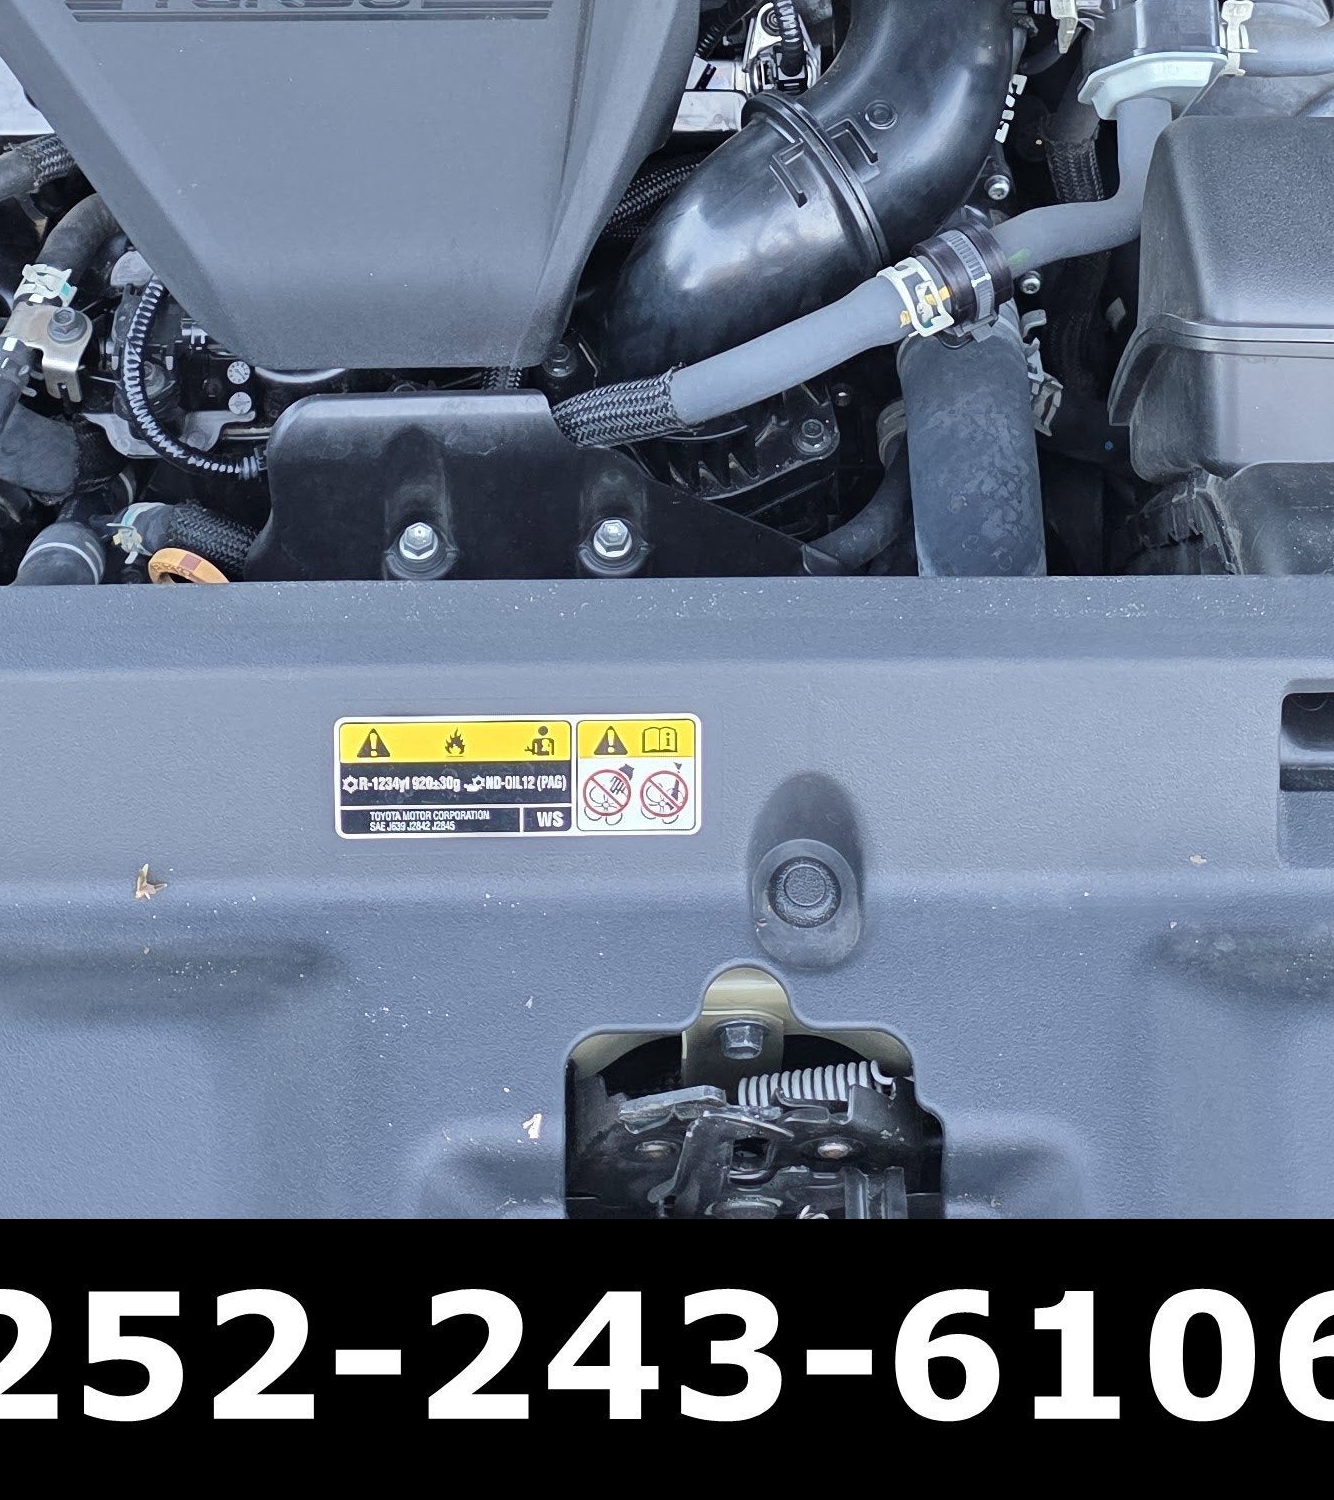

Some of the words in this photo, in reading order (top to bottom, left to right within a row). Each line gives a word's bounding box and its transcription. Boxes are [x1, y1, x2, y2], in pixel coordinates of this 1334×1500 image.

[358, 775, 410, 793] R-1234yf
[537, 775, 566, 792] (PAG)
[370, 810, 403, 821] TOYOTA
[403, 810, 433, 820] MOTOR
[433, 810, 490, 820] CORPORATION
[537, 811, 564, 827] WS
[369, 822, 386, 831] SAE
[386, 822, 406, 831] J639
[407, 821, 431, 831] J2842
[431, 821, 455, 831] J2845
